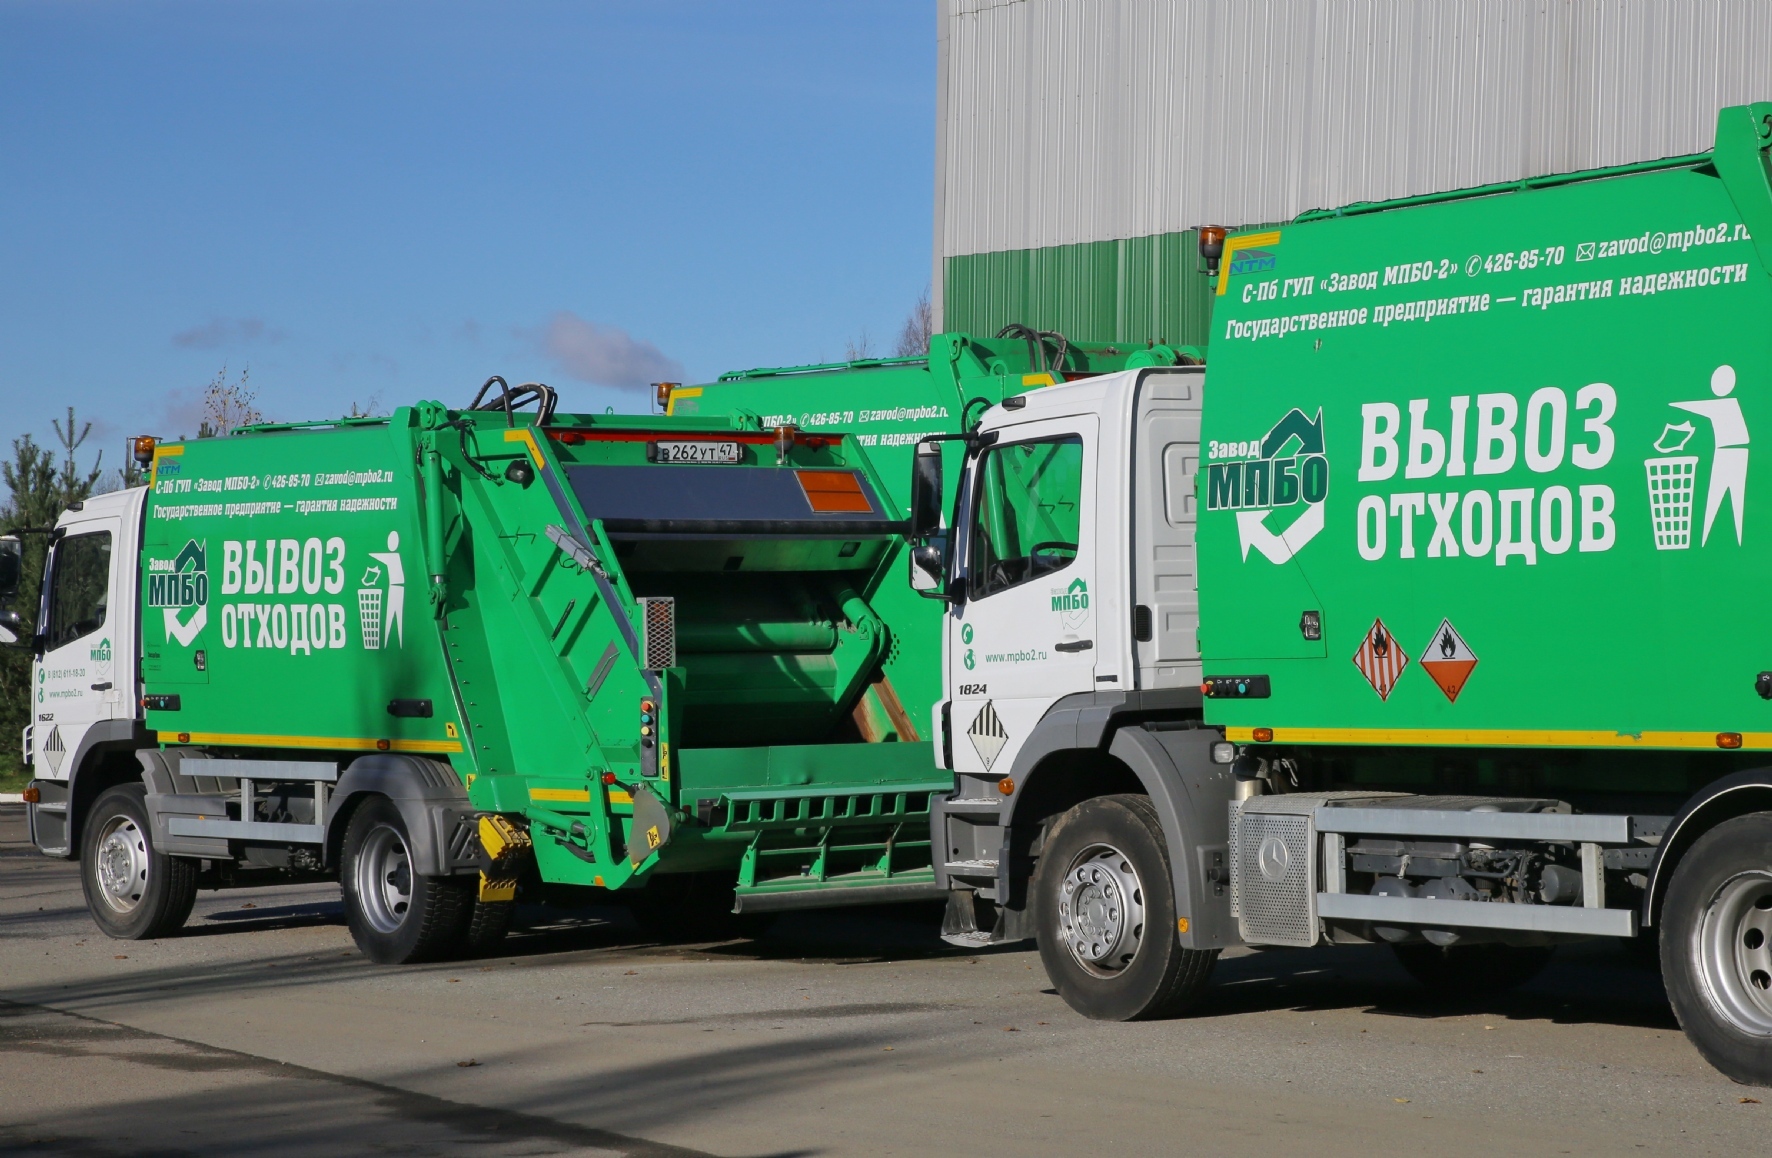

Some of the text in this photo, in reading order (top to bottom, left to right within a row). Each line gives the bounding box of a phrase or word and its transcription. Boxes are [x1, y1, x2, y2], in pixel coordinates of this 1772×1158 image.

[1229, 256, 1276, 275] NTM
[1242, 278, 1278, 304] С-Пб
[1282, 275, 1315, 298] ГУП
[1320, 270, 1379, 293] «Завод
[1383, 258, 1458, 287] МПБО-2»
[1484, 245, 1565, 274] 426-85-70
[1225, 307, 1368, 342] Государственное
[1373, 293, 1491, 327] предприятие
[1522, 279, 1614, 310] гарантия
[1619, 263, 1749, 296] надежности
[810, 411, 854, 426] 426-85-70
[1358, 383, 1617, 482] ВЫВОЗ
[1209, 440, 1260, 461] Завод
[157, 465, 180, 475] NTM
[156, 480, 174, 495] С-Пб
[175, 478, 192, 493] ГУП
[224, 475, 260, 491] МПБО-2»
[272, 473, 311, 488] 426-85-70
[325, 469, 394, 487] zavod@mpbo2.ru
[1207, 455, 1329, 511] МПБО
[153, 503, 223, 522] Государственное
[225, 501, 282, 519] предприятие
[296, 499, 338, 516] гарантия
[340, 497, 398, 514] надежности
[1357, 484, 1616, 566] ОТХОДОВ
[149, 558, 175, 572] Завод
[222, 537, 346, 595] ВЫВОЗ
[148, 572, 208, 607] МПБО
[1051, 593, 1089, 612] МПБО
[221, 603, 346, 655] ОТХОДОВ
[90, 649, 112, 661] МПБО
[985, 649, 1047, 664] www.mpbo2.ru
[49, 688, 84, 699] www.mpbo2.ru
[959, 684, 987, 695] 1824
[1446, 685, 1456, 694] 4.2
[39, 713, 54, 721] 1622
